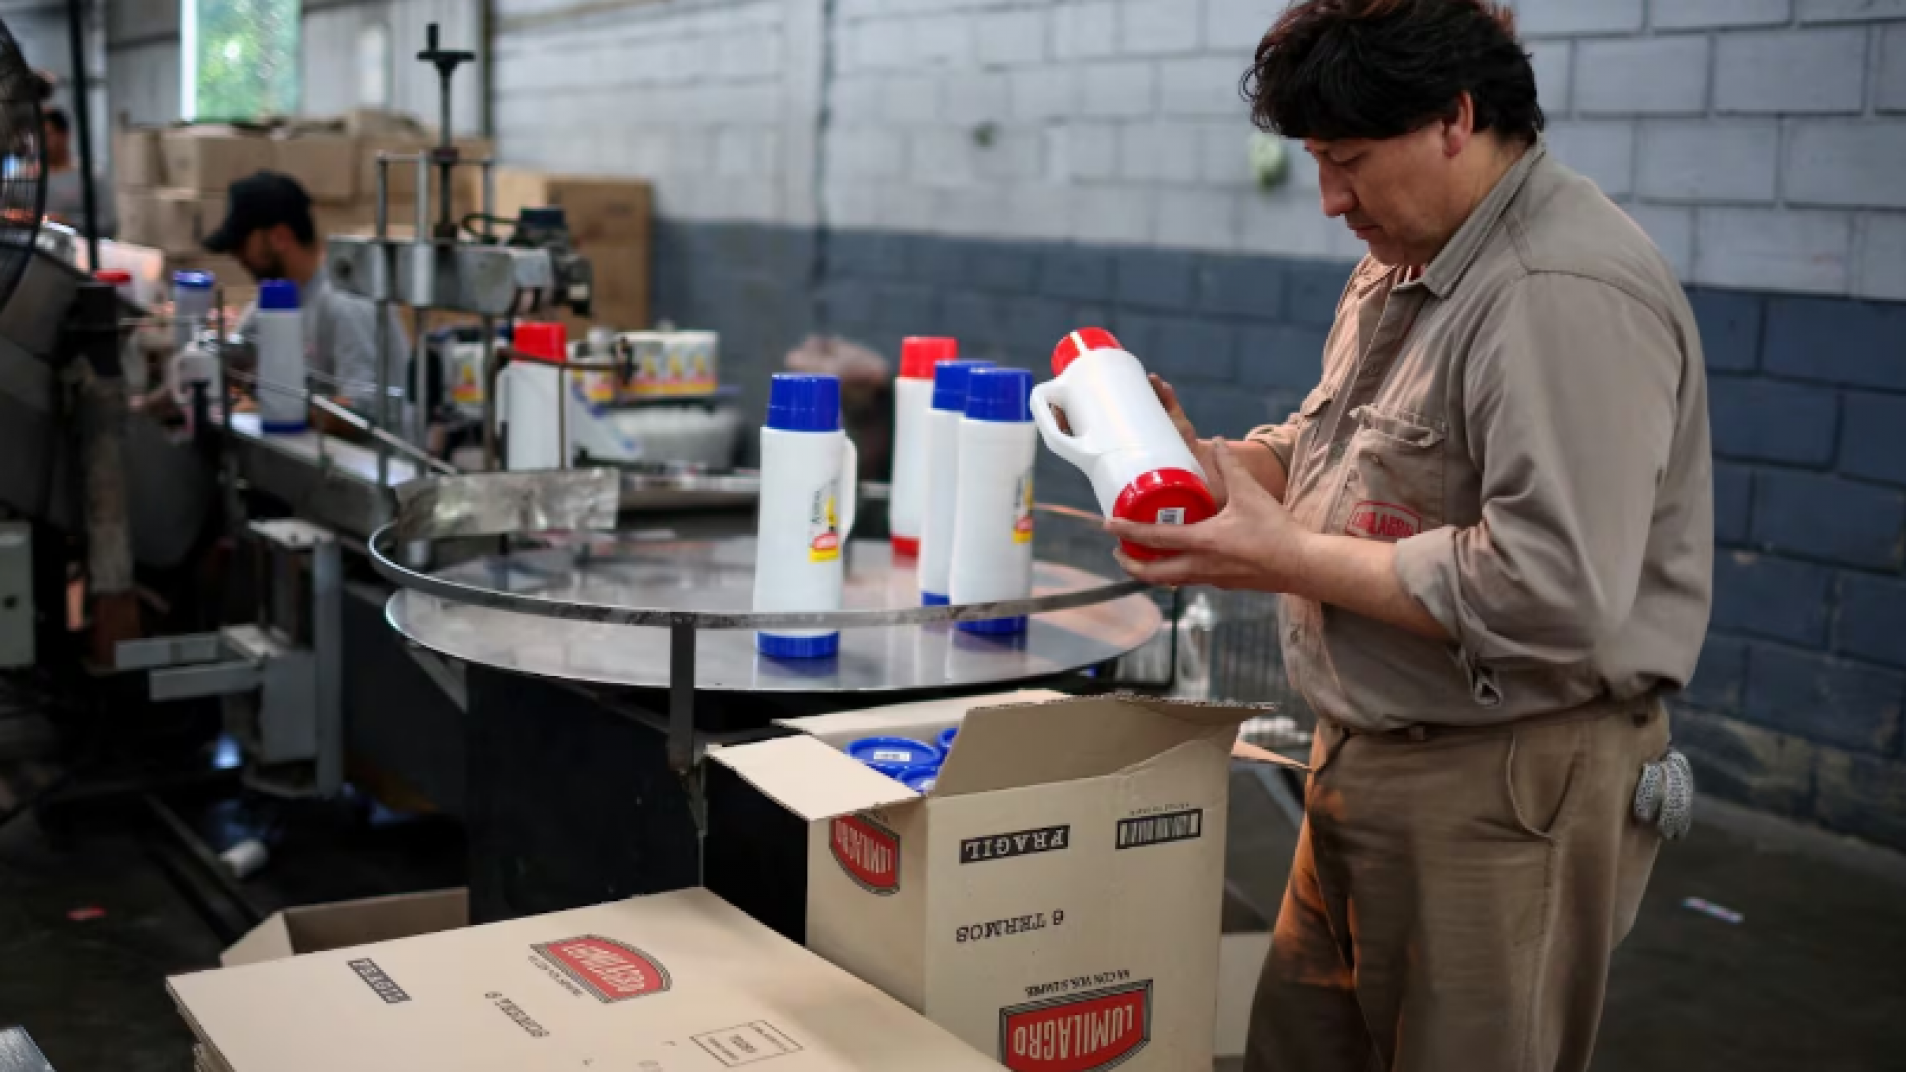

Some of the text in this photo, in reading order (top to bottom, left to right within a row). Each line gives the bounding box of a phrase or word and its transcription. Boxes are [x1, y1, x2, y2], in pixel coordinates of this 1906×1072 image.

[965, 828, 1064, 860] FRAGIL
[956, 909, 1064, 942] 6 TERMOS
[1013, 1004, 1133, 1061] LUMILAGRO
